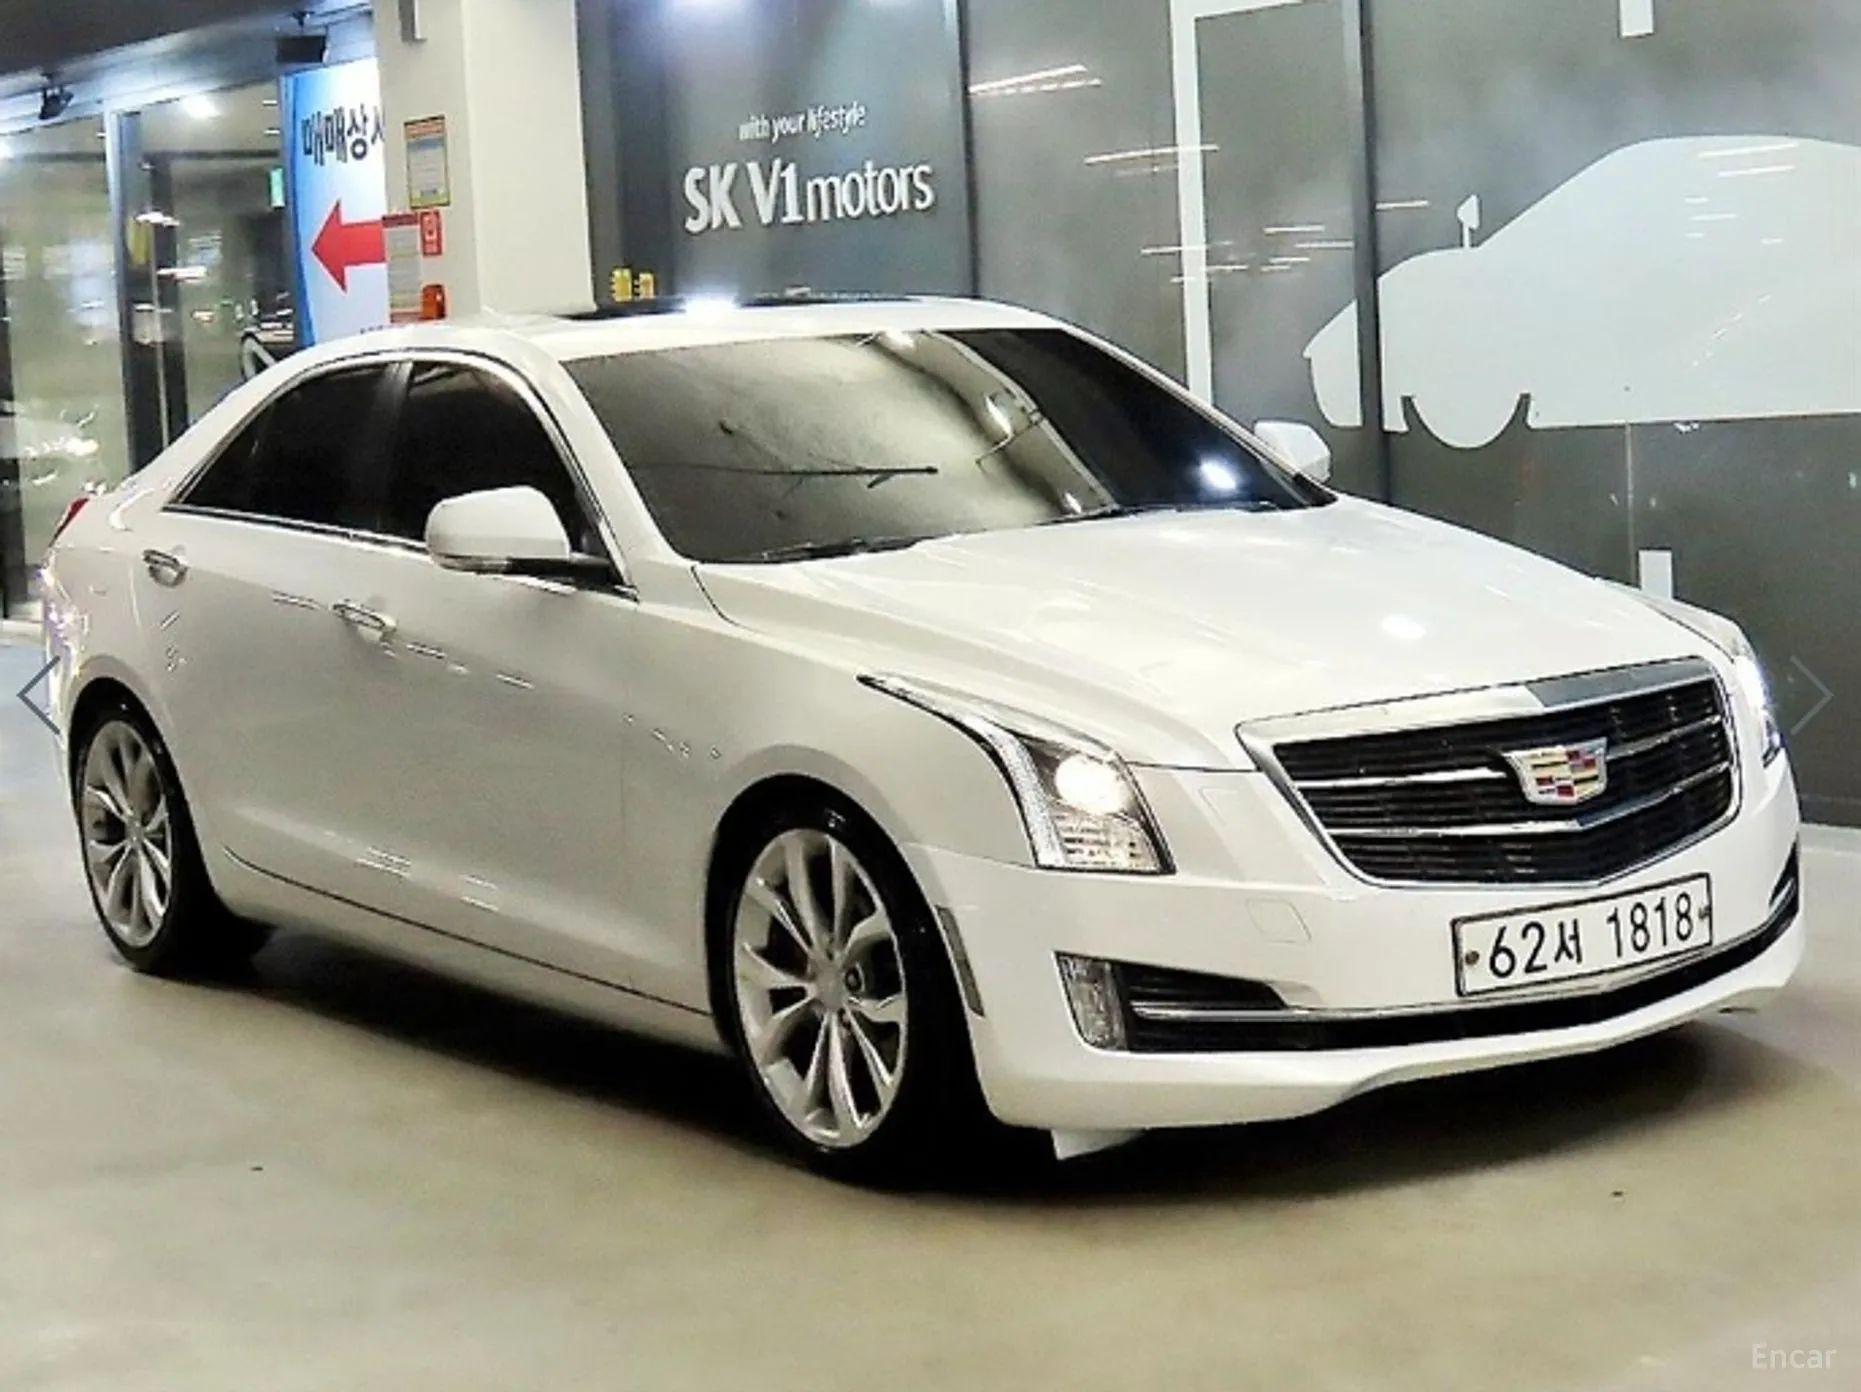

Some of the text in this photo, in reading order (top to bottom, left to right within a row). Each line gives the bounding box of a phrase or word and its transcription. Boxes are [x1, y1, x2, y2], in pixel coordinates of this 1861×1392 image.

[738, 100, 866, 143] with your lifestyle
[684, 162, 742, 234] SK
[1489, 891, 1694, 978] 62서 1818
